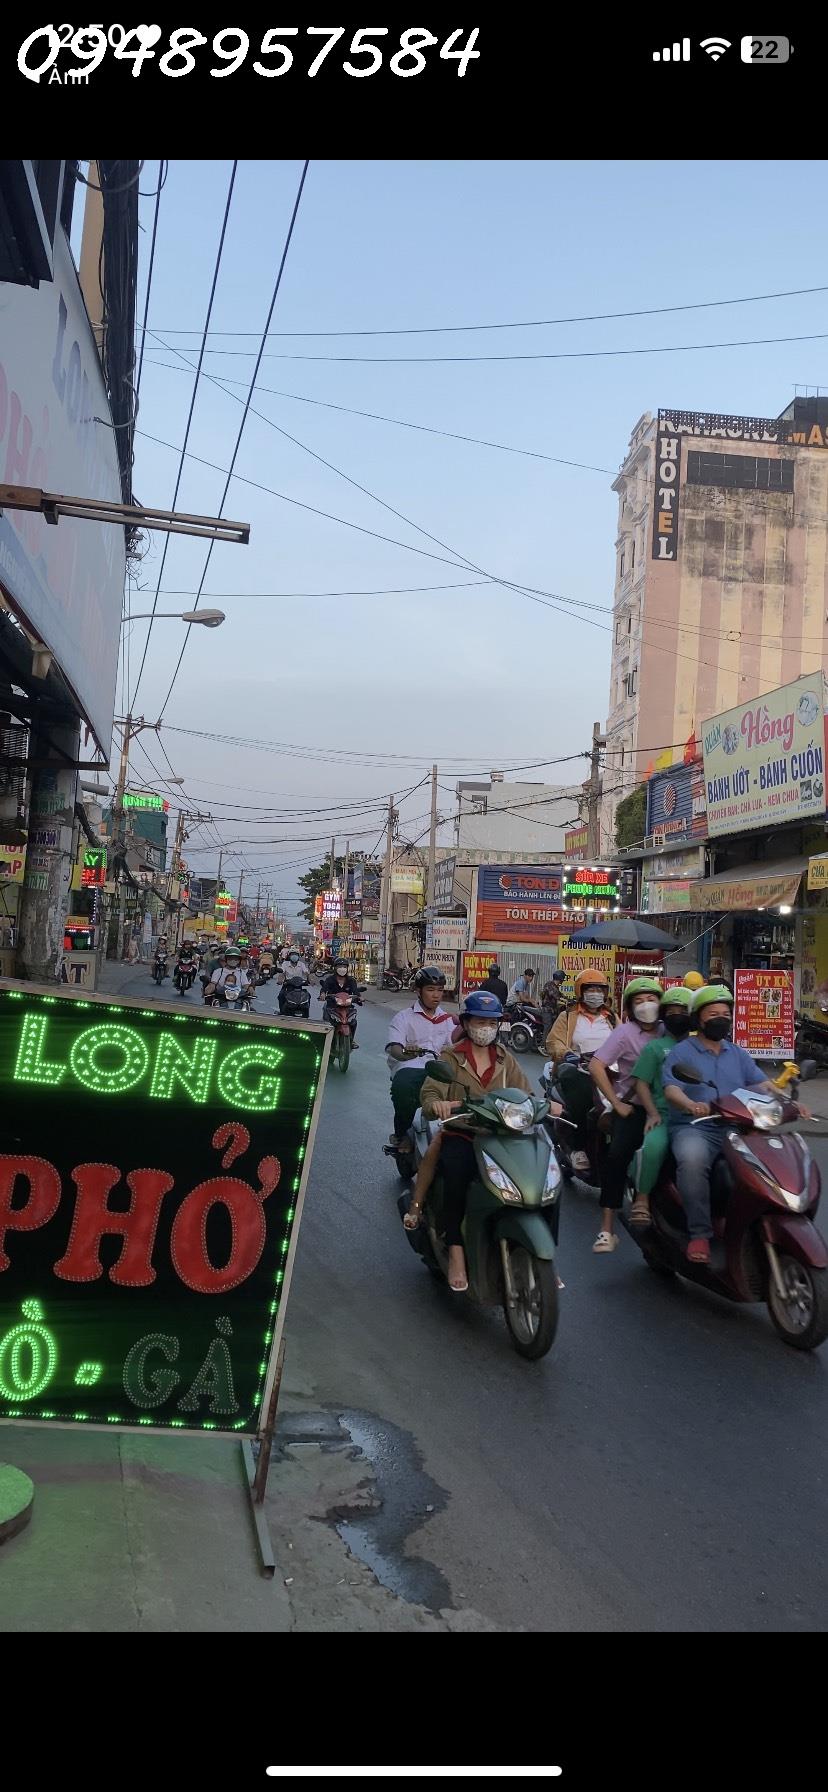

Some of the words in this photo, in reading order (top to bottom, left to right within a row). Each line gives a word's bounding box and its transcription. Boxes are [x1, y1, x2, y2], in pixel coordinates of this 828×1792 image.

[749, 40, 779, 60] 22
[658, 437, 678, 559] HOTEL
[741, 704, 795, 752] Hồng
[707, 774, 731, 804] BÁNH
[759, 756, 788, 790] BÁNH
[790, 739, 823, 781] CUỐN
[322, 902, 341, 911] YOGA
[324, 893, 340, 902] GYM
[505, 906, 529, 920] TÔN
[531, 906, 559, 921] THÉP
[589, 953, 612, 972] PHÁT
[756, 973, 771, 987] ÚT
[13, 1013, 285, 1111] LONG
[0, 1121, 282, 1295] PHỞ
[122, 1315, 241, 1416] GÀ
